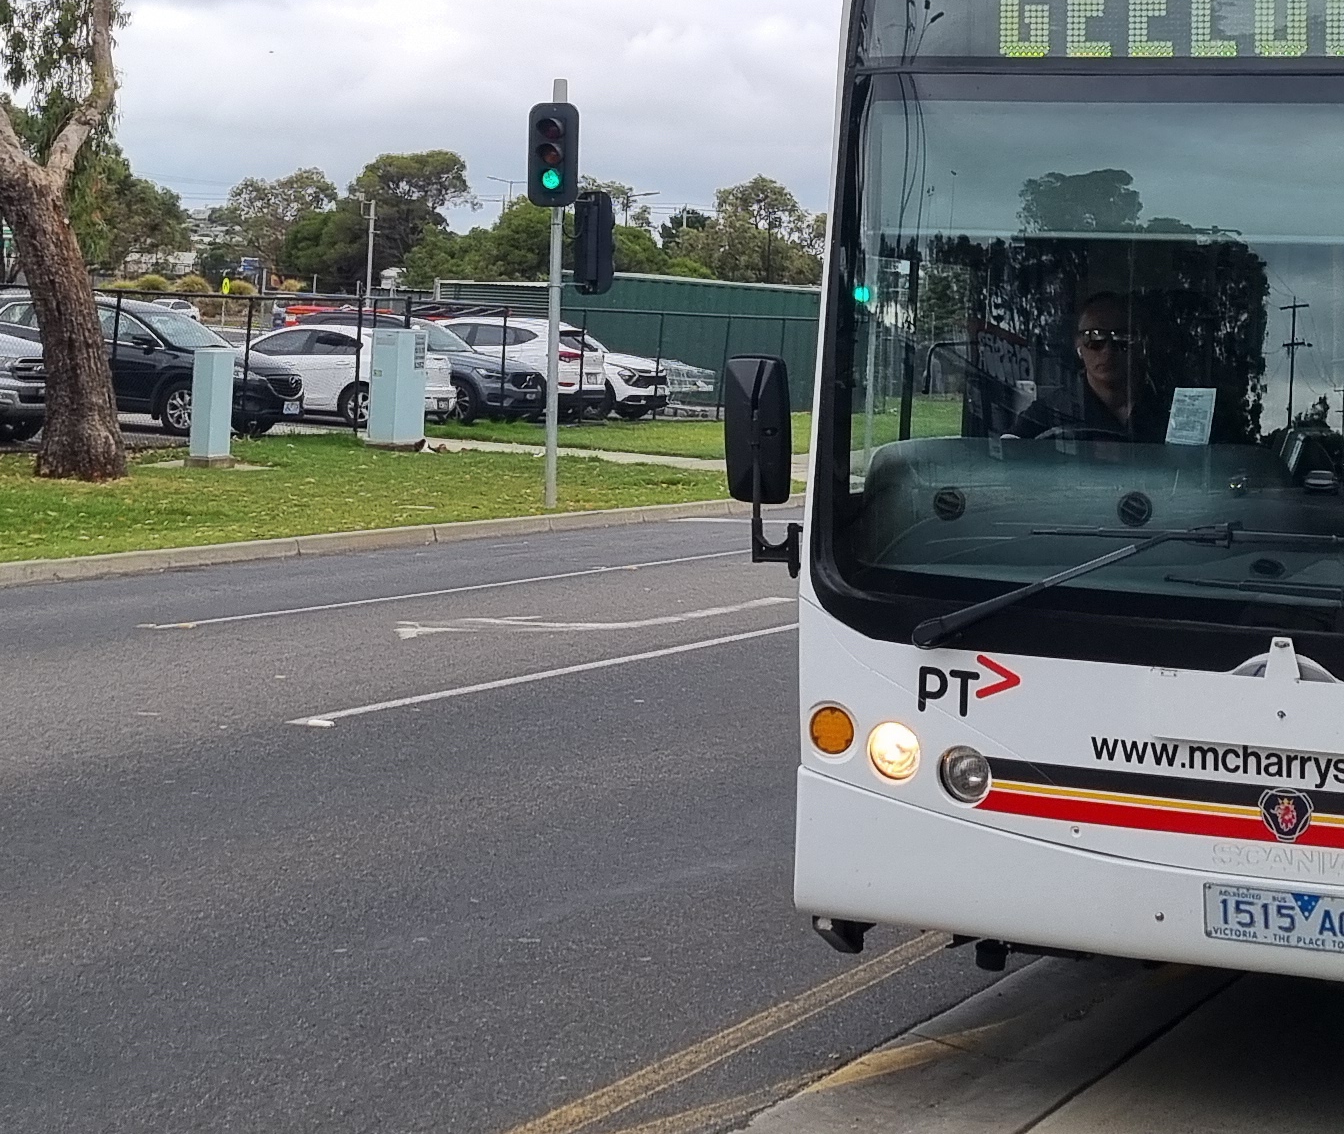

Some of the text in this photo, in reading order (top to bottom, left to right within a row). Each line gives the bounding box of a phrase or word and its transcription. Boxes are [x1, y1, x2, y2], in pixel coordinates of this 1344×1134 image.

[1272, 895, 1288, 903] BUS
[1220, 898, 1297, 933] 1515
[1212, 926, 1258, 940] VICTORIA
[1273, 933, 1291, 945] THE
[1296, 935, 1326, 948] PLACE
[1332, 940, 1344, 950] TO
